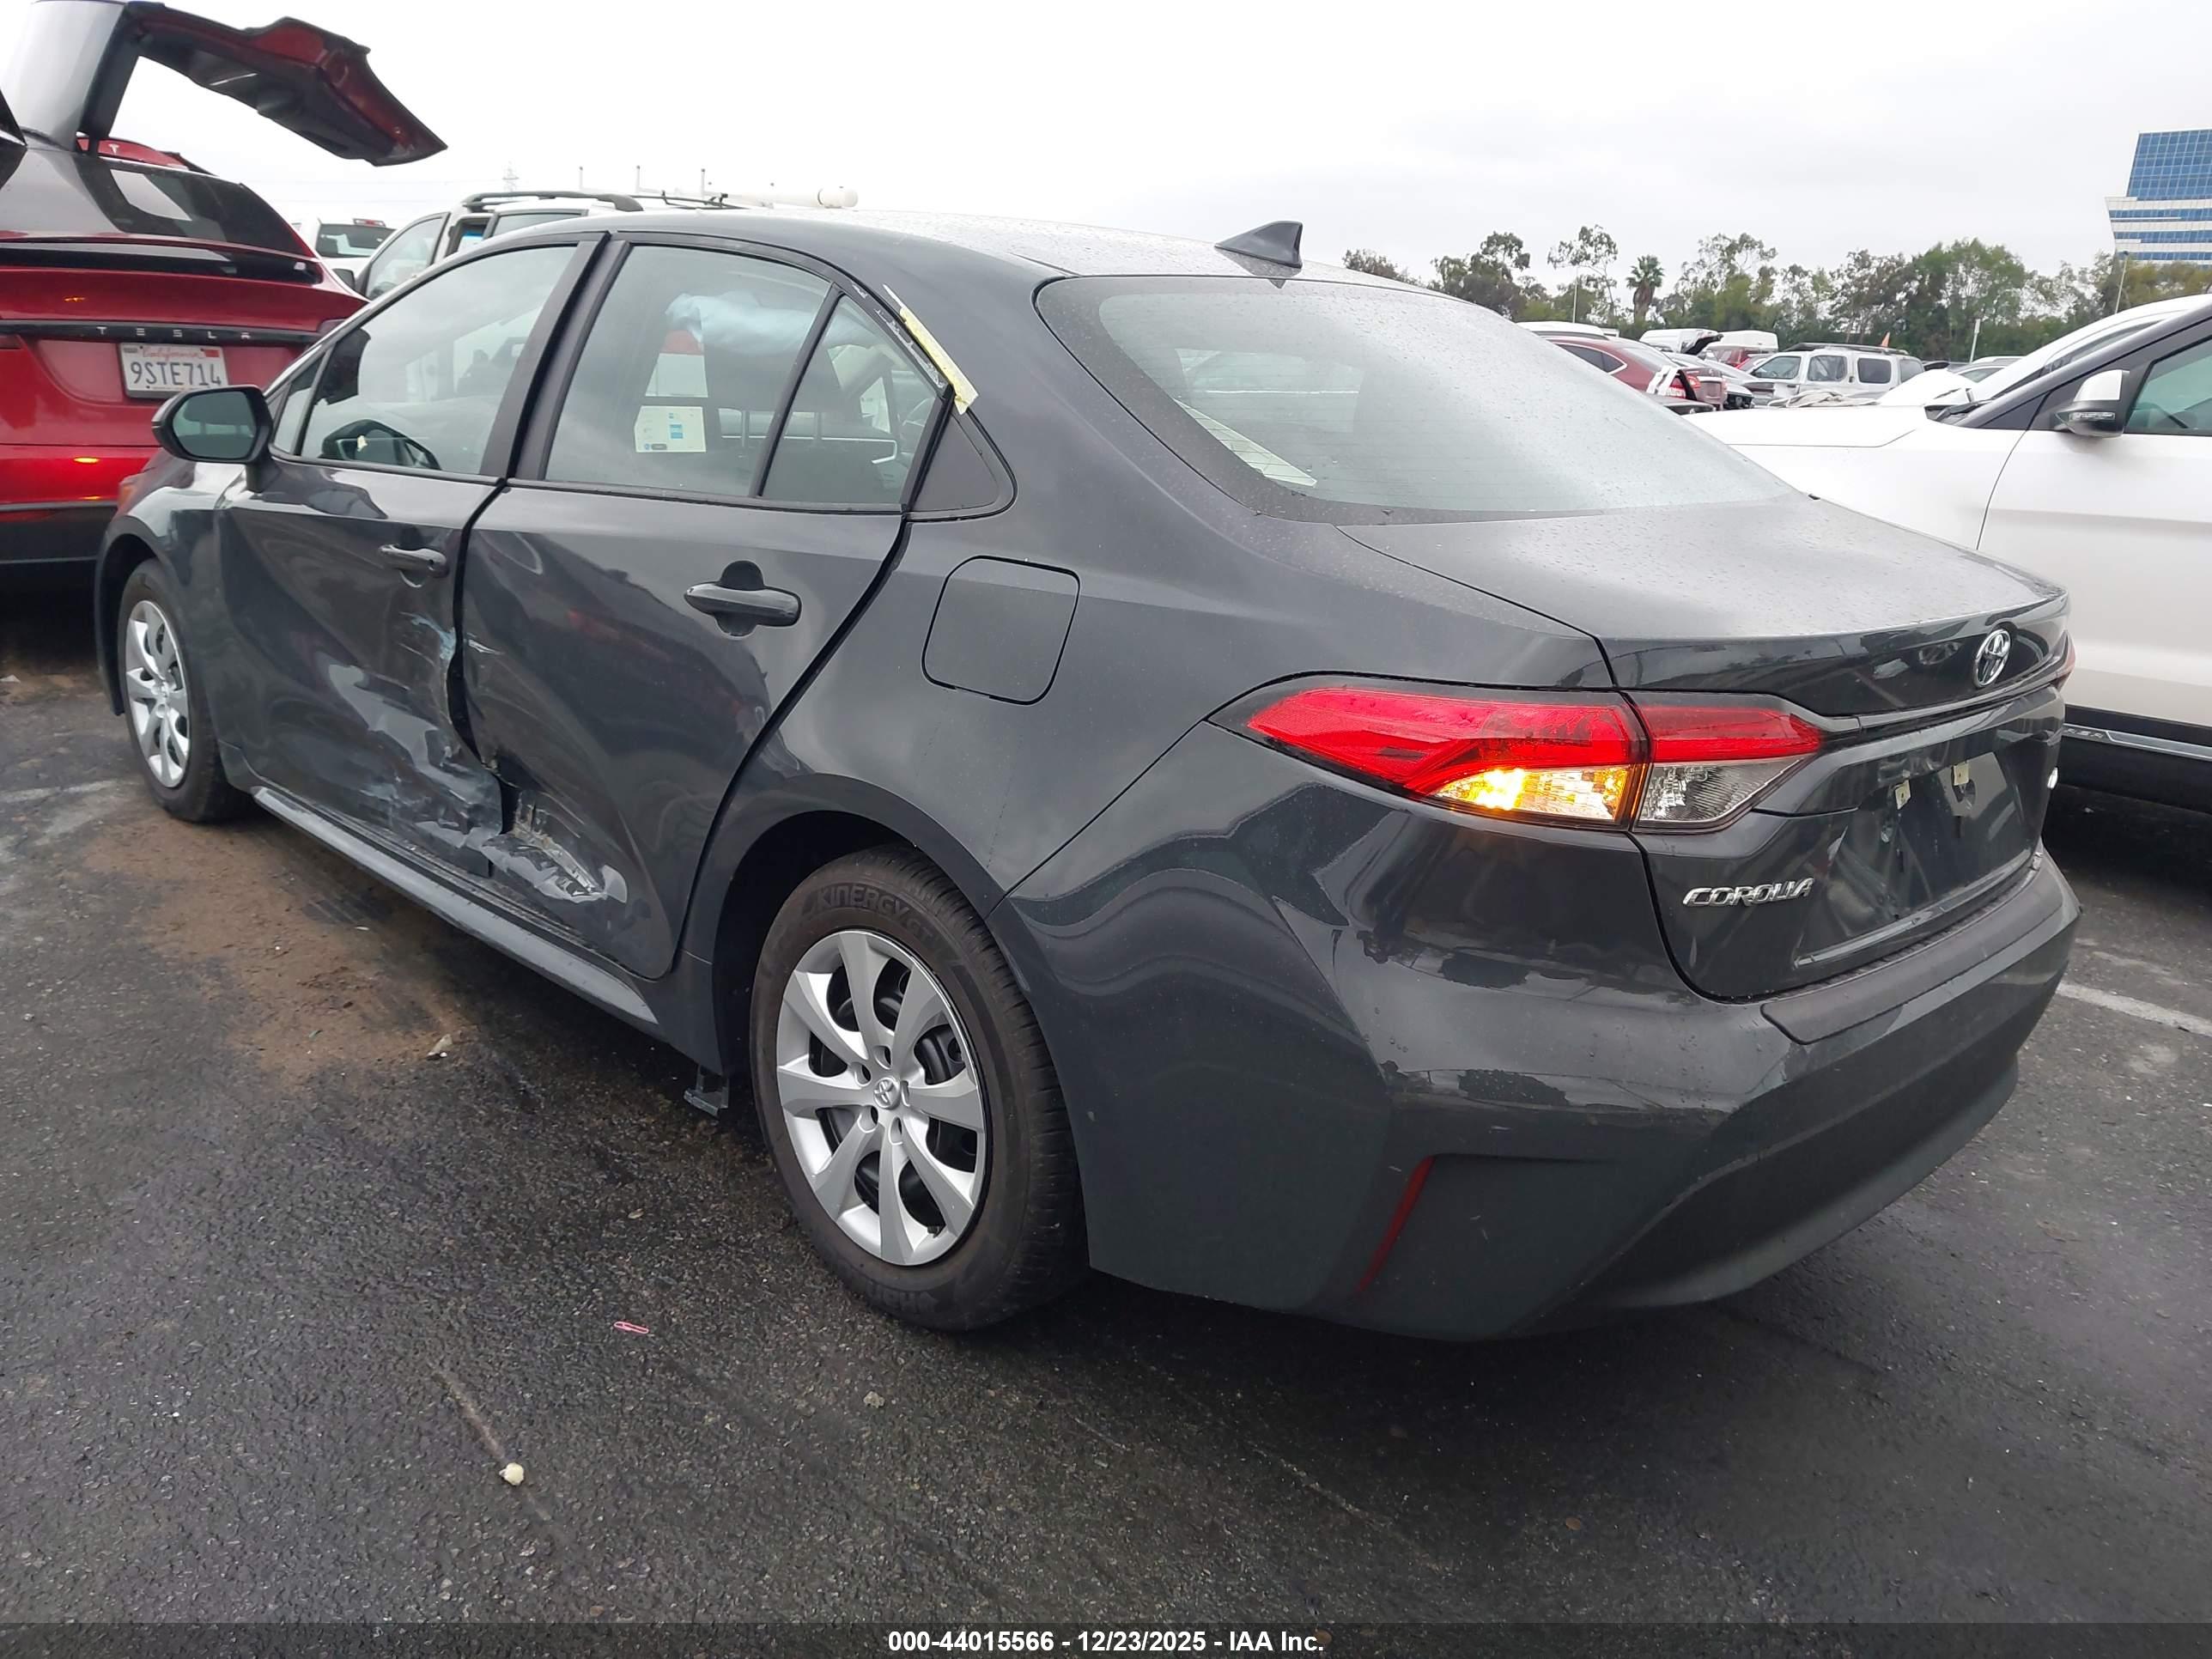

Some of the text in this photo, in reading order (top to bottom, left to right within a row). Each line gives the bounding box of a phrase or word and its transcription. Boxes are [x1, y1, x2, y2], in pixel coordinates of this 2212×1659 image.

[96, 325, 251, 340] TESLA
[130, 361, 222, 386] 9STE714
[817, 883, 910, 916] KINERGY
[1682, 877, 1814, 907] COROLLA
